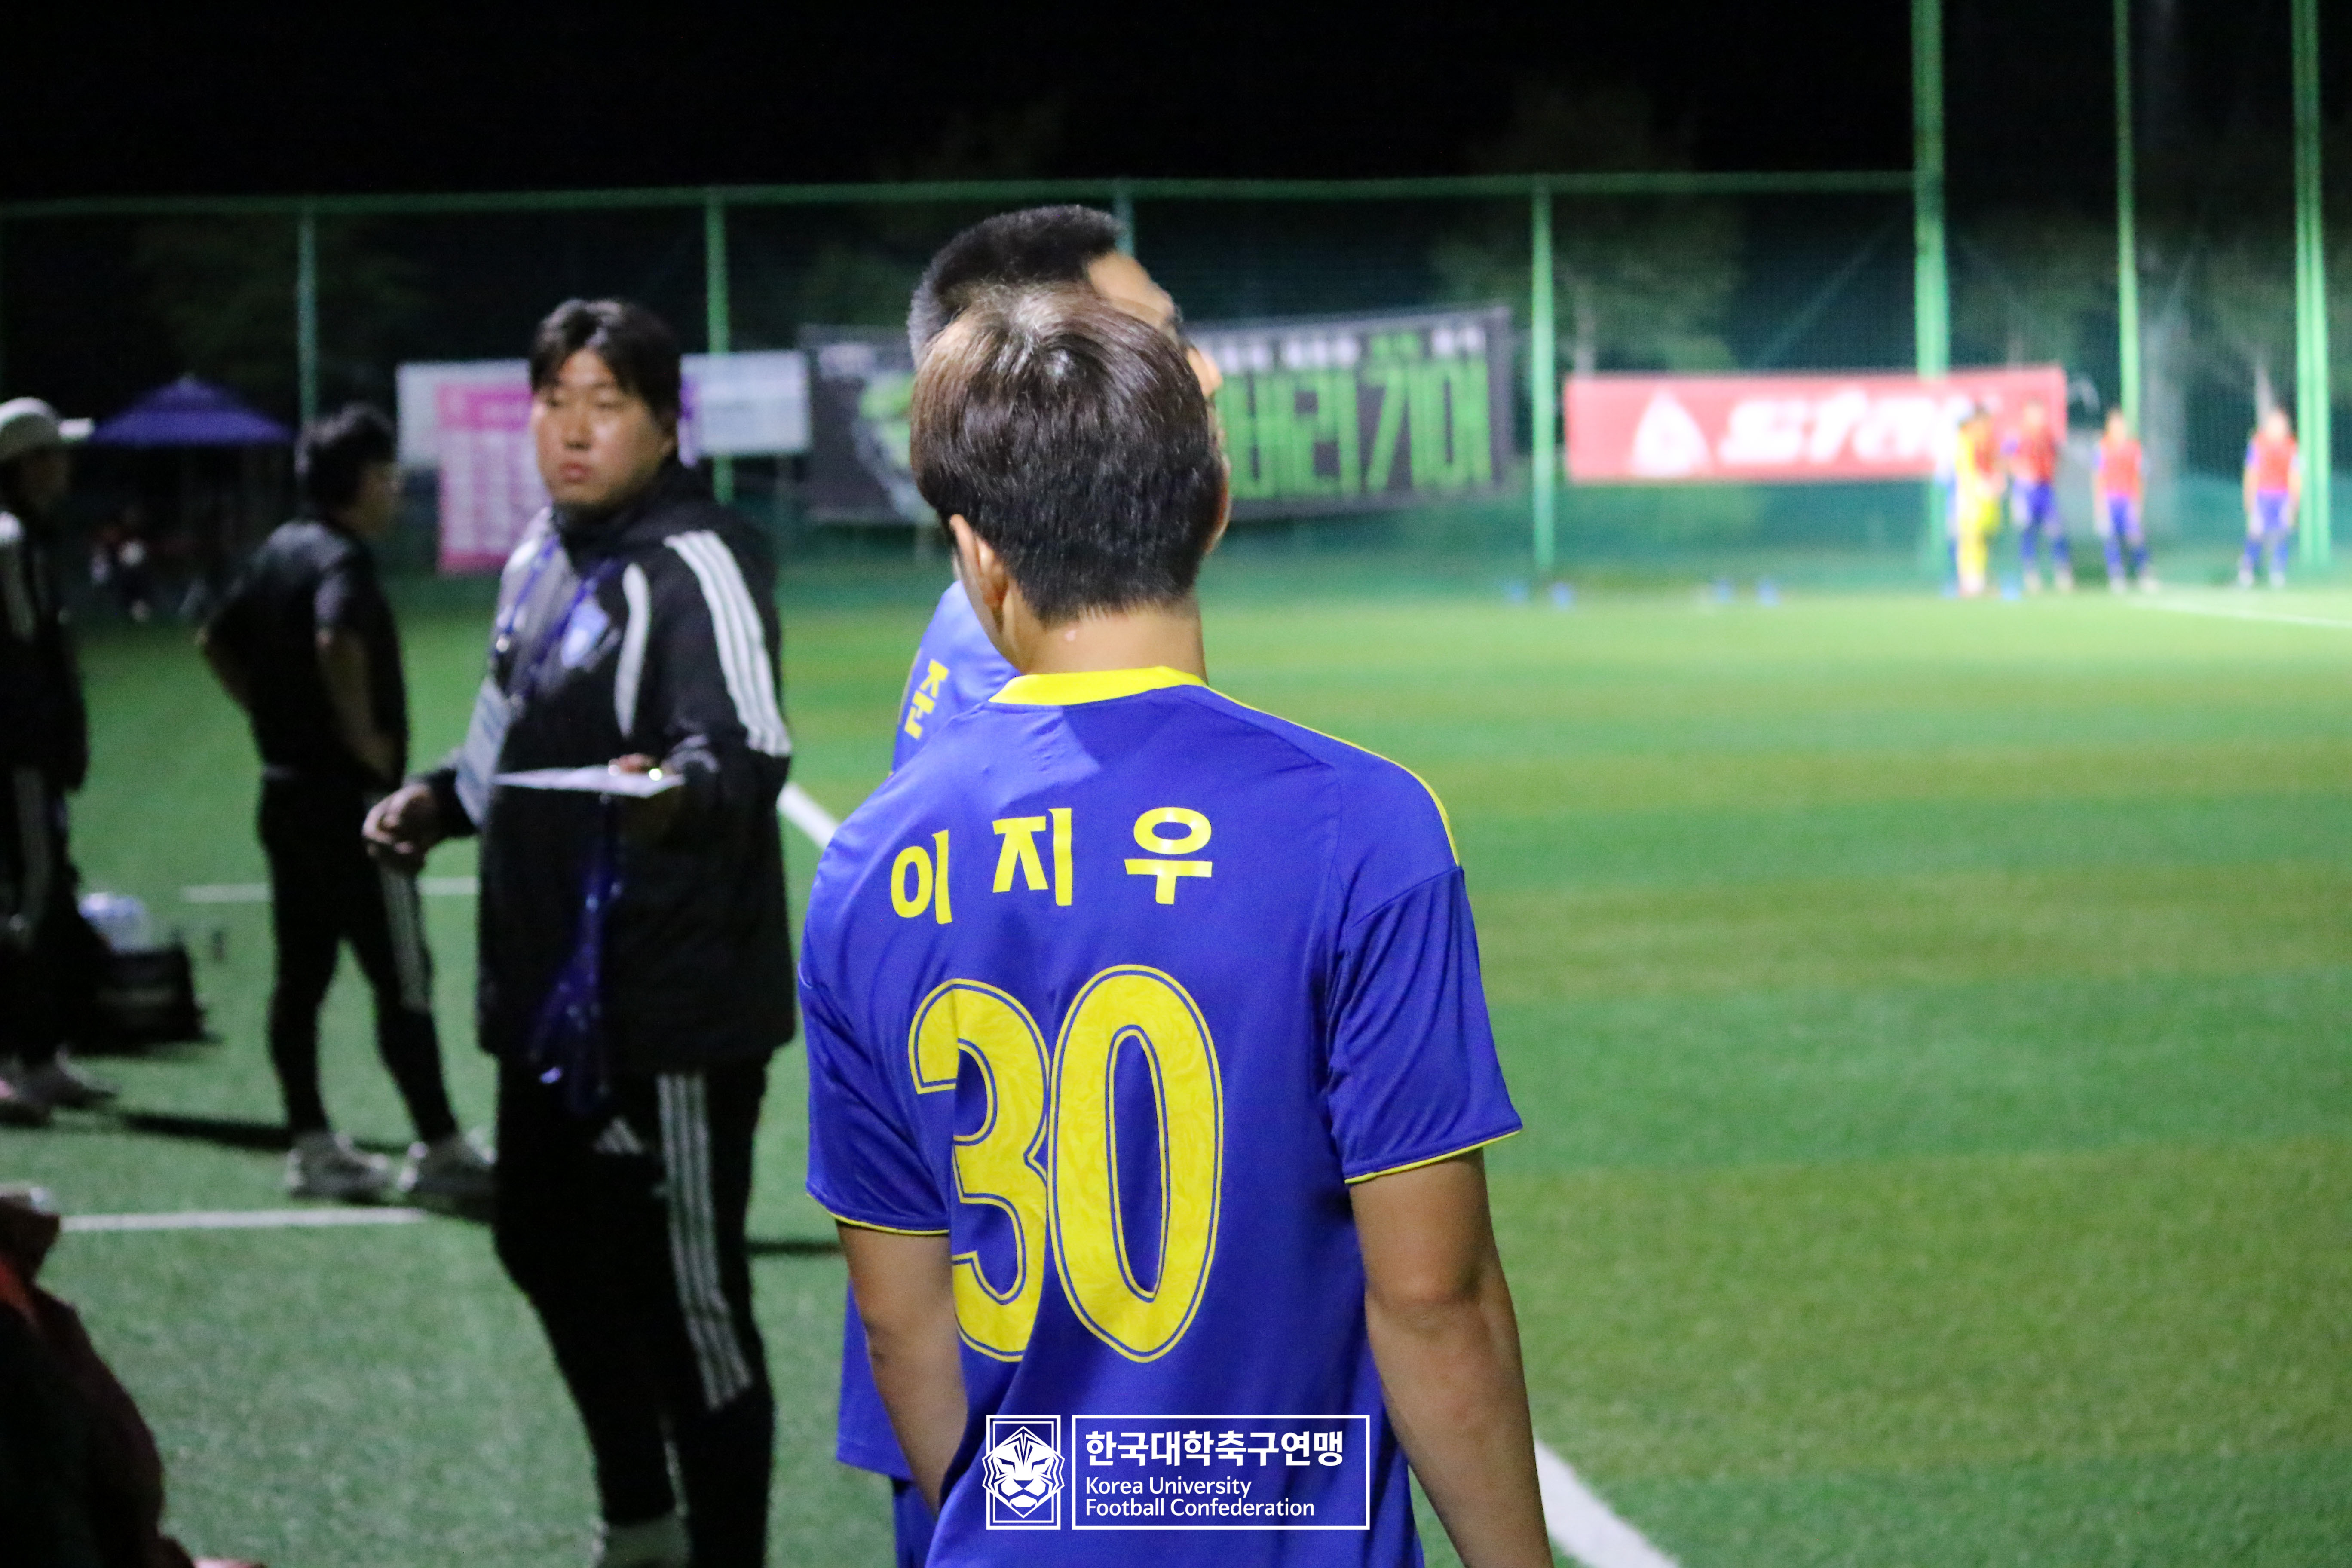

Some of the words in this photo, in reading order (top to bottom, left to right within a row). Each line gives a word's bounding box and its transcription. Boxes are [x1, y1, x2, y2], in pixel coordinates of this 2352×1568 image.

[905, 658, 949, 740] 준
[891, 807, 1212, 925] 이지우
[908, 964, 1224, 1363] 30
